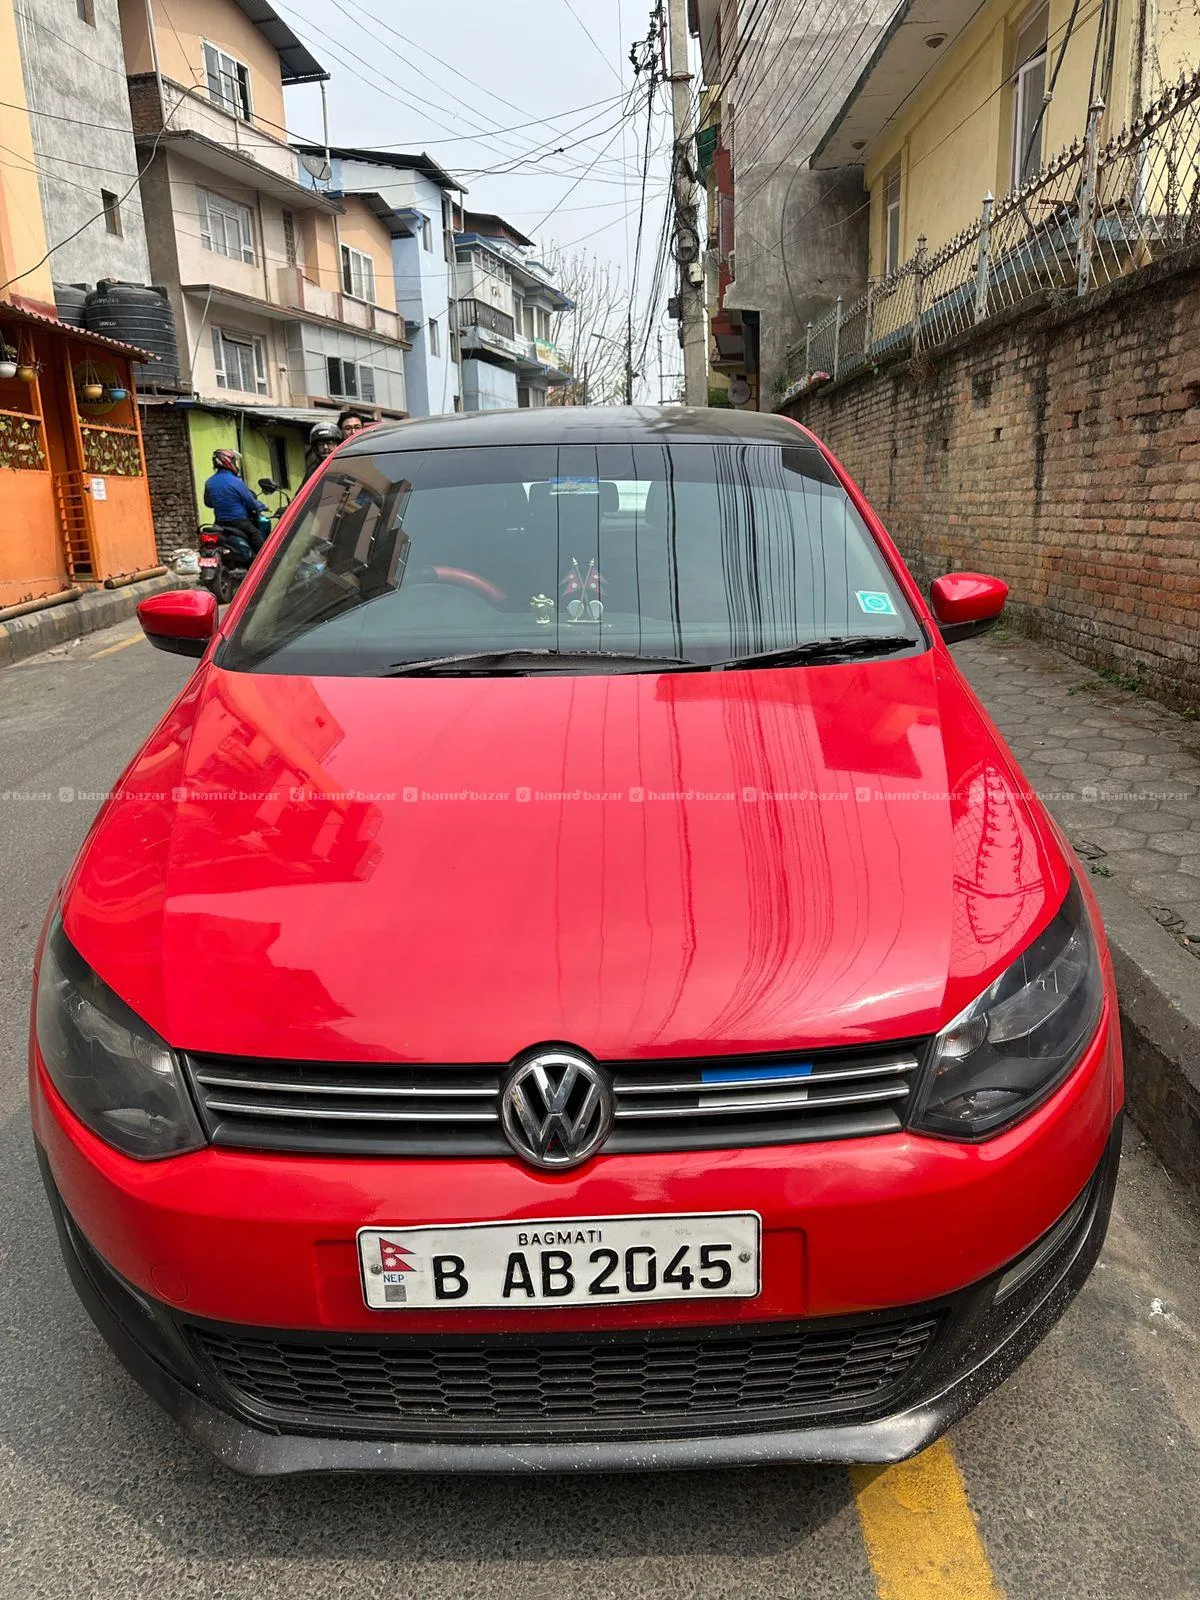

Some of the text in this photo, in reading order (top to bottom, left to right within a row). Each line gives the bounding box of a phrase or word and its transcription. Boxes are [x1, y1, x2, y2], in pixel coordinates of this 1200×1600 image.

[518, 1230, 603, 1246] BAGMATI
[383, 1273, 405, 1283] NEP
[433, 1255, 469, 1300] B
